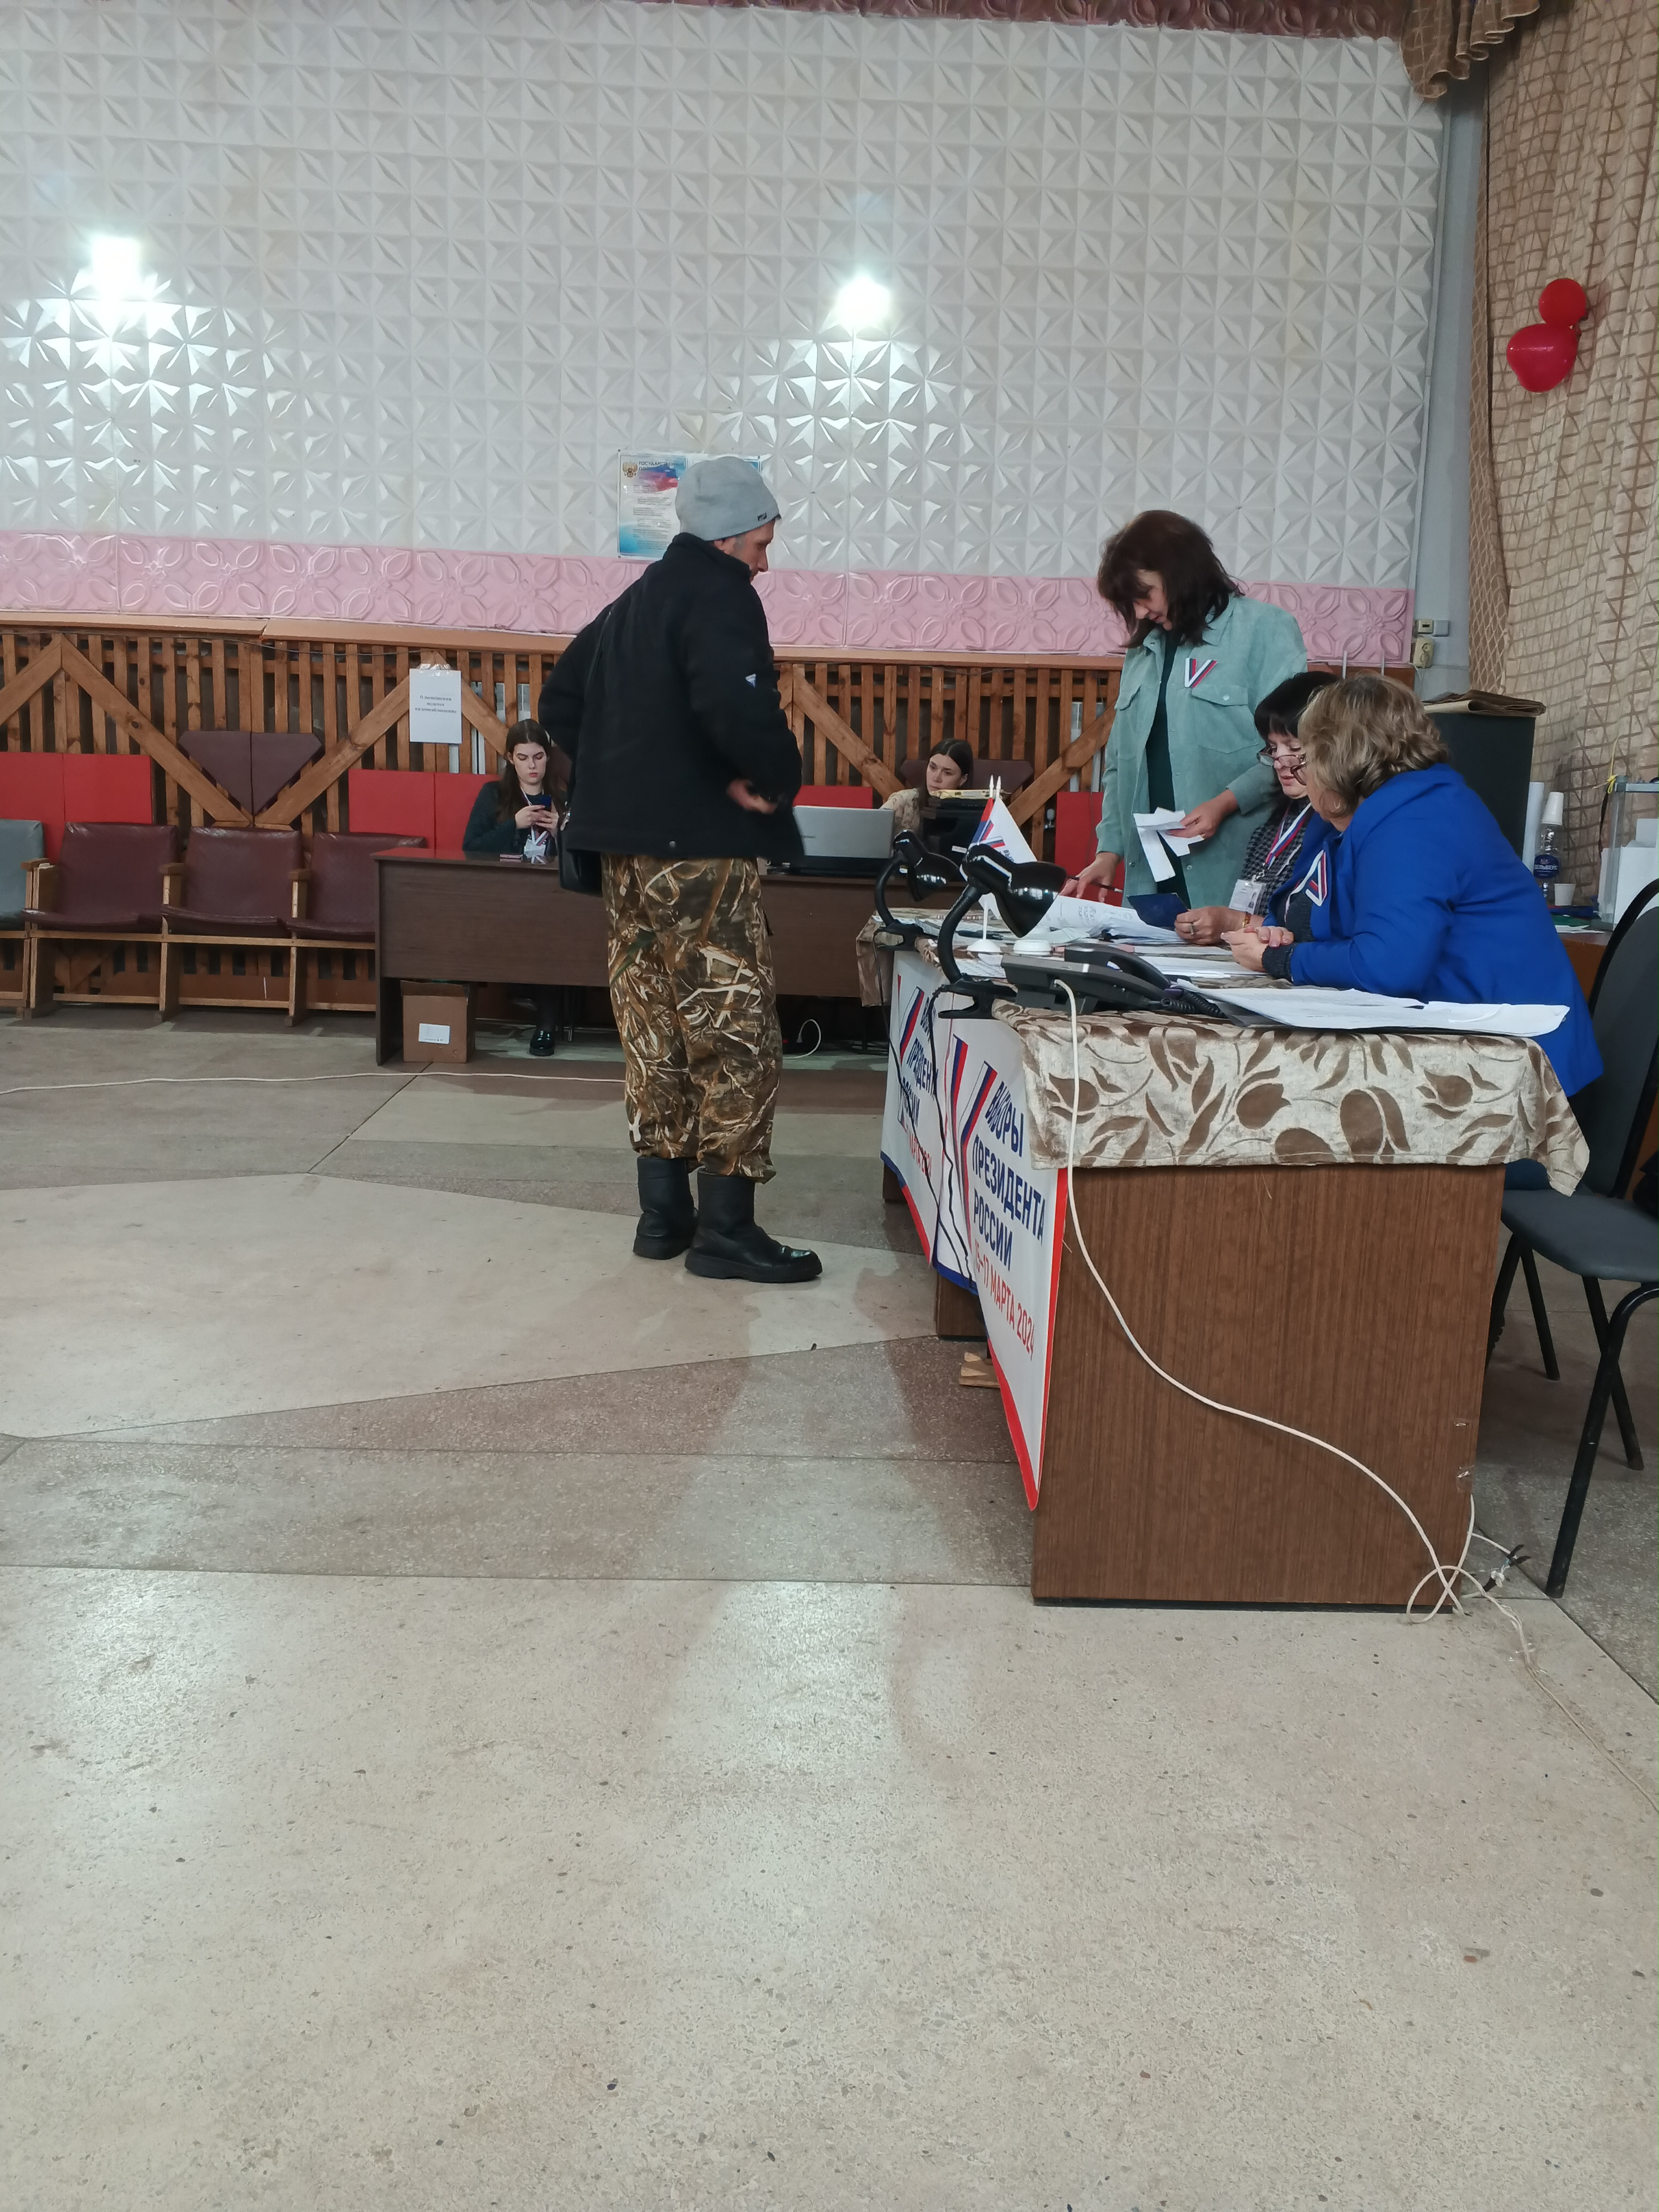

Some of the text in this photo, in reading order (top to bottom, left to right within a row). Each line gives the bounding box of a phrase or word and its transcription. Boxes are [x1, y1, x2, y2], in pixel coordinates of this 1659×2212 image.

[985, 1081, 1024, 1158] ВЫБОРЫ
[973, 1134, 1045, 1247] ПРЕЗИДЕНТА
[974, 1188, 1013, 1272] РОССИИ
[990, 1263, 1015, 1330] МАРТА
[1017, 1302, 1035, 1361] 2024
